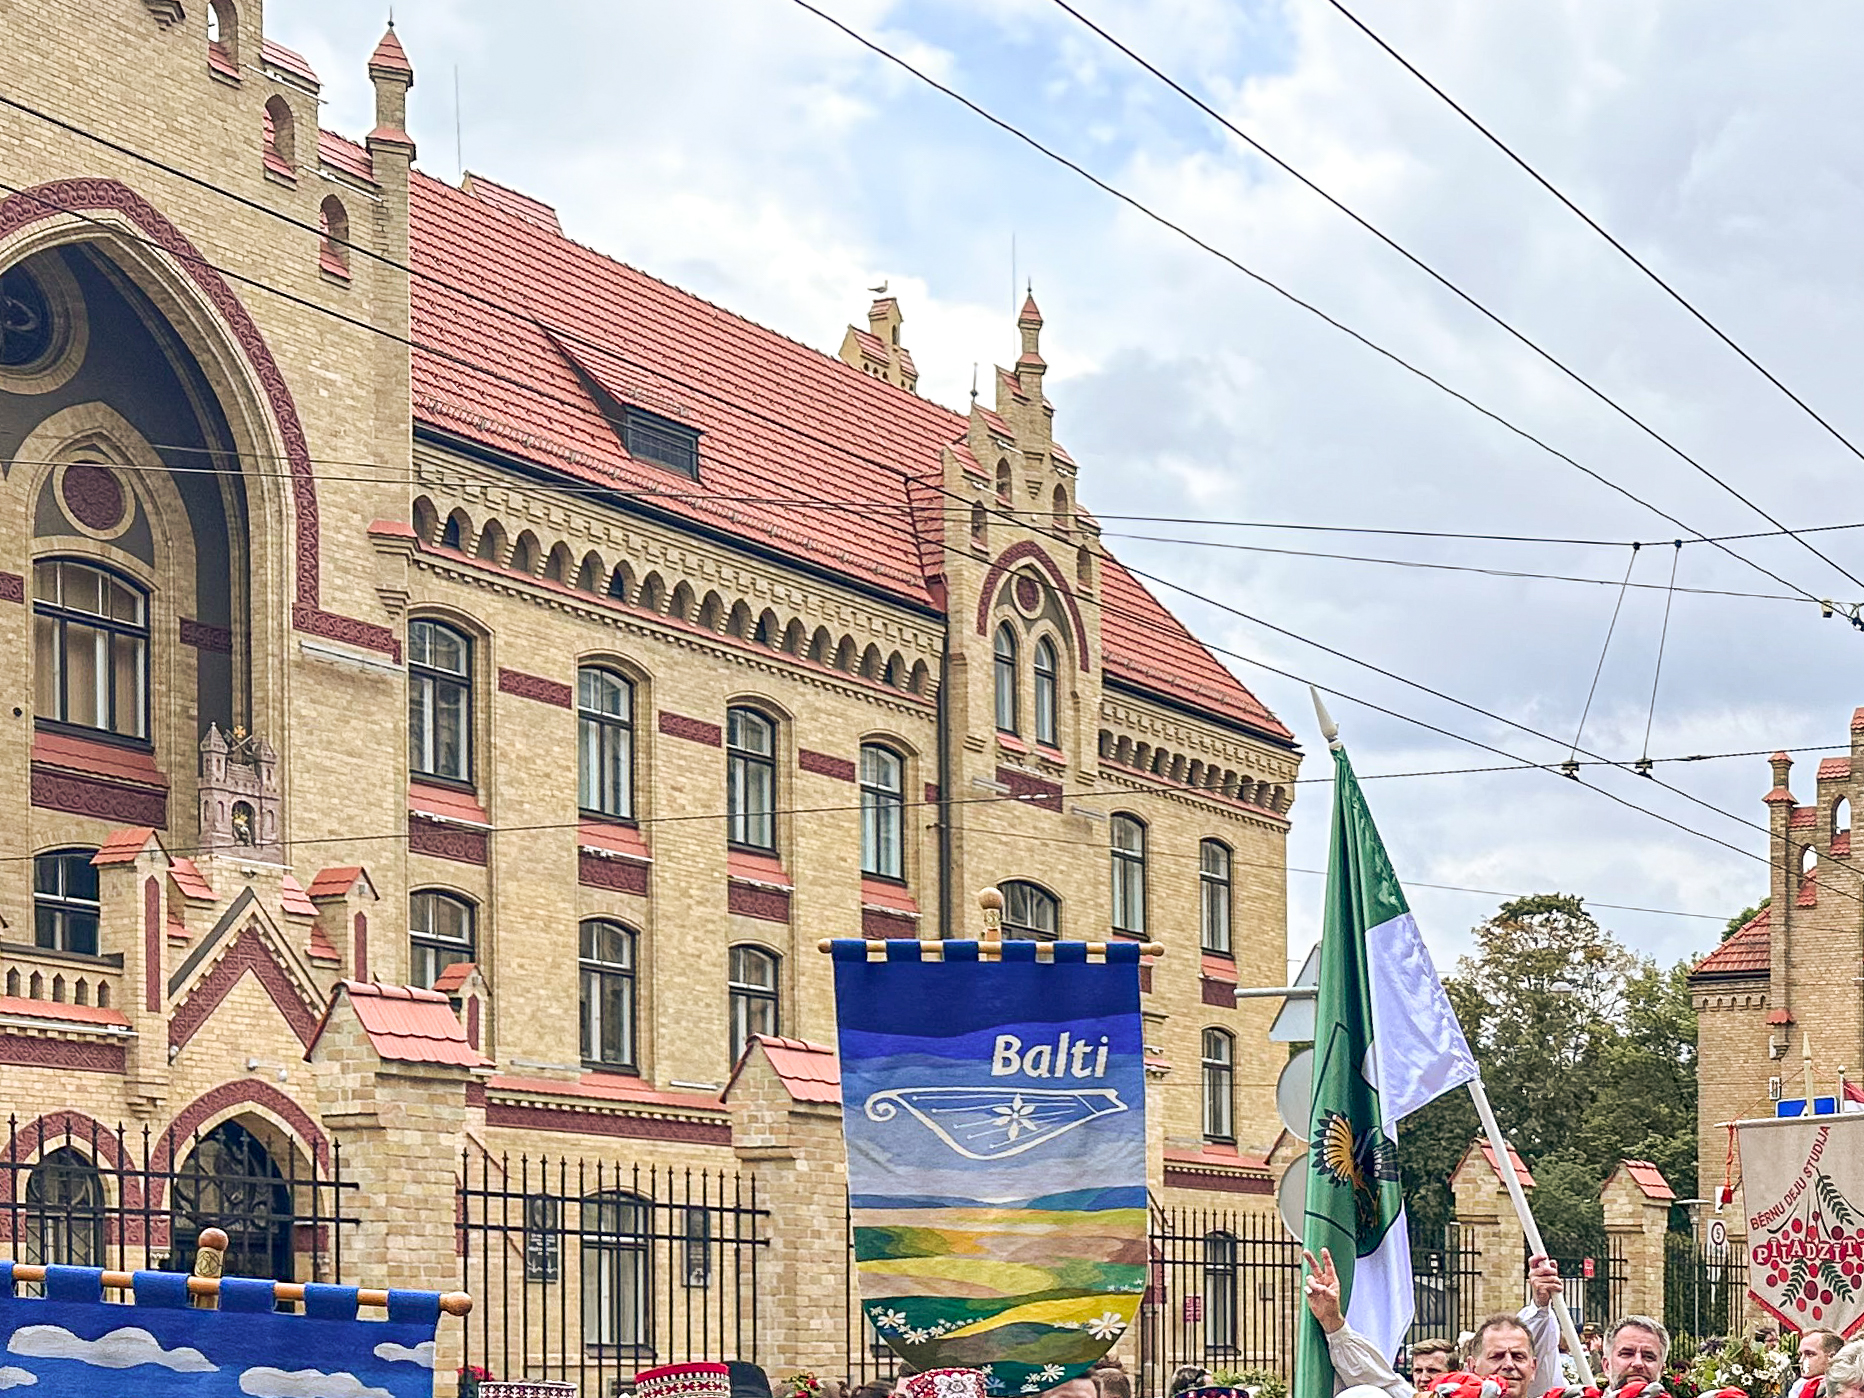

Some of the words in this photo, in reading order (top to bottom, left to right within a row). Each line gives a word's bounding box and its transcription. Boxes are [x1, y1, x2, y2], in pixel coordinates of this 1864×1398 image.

[990, 1031, 1109, 1078] Balti
[1749, 1202, 1786, 1231] BĒRNU
[1783, 1176, 1807, 1208] DEJU
[1803, 1125, 1831, 1178] STUDIJA
